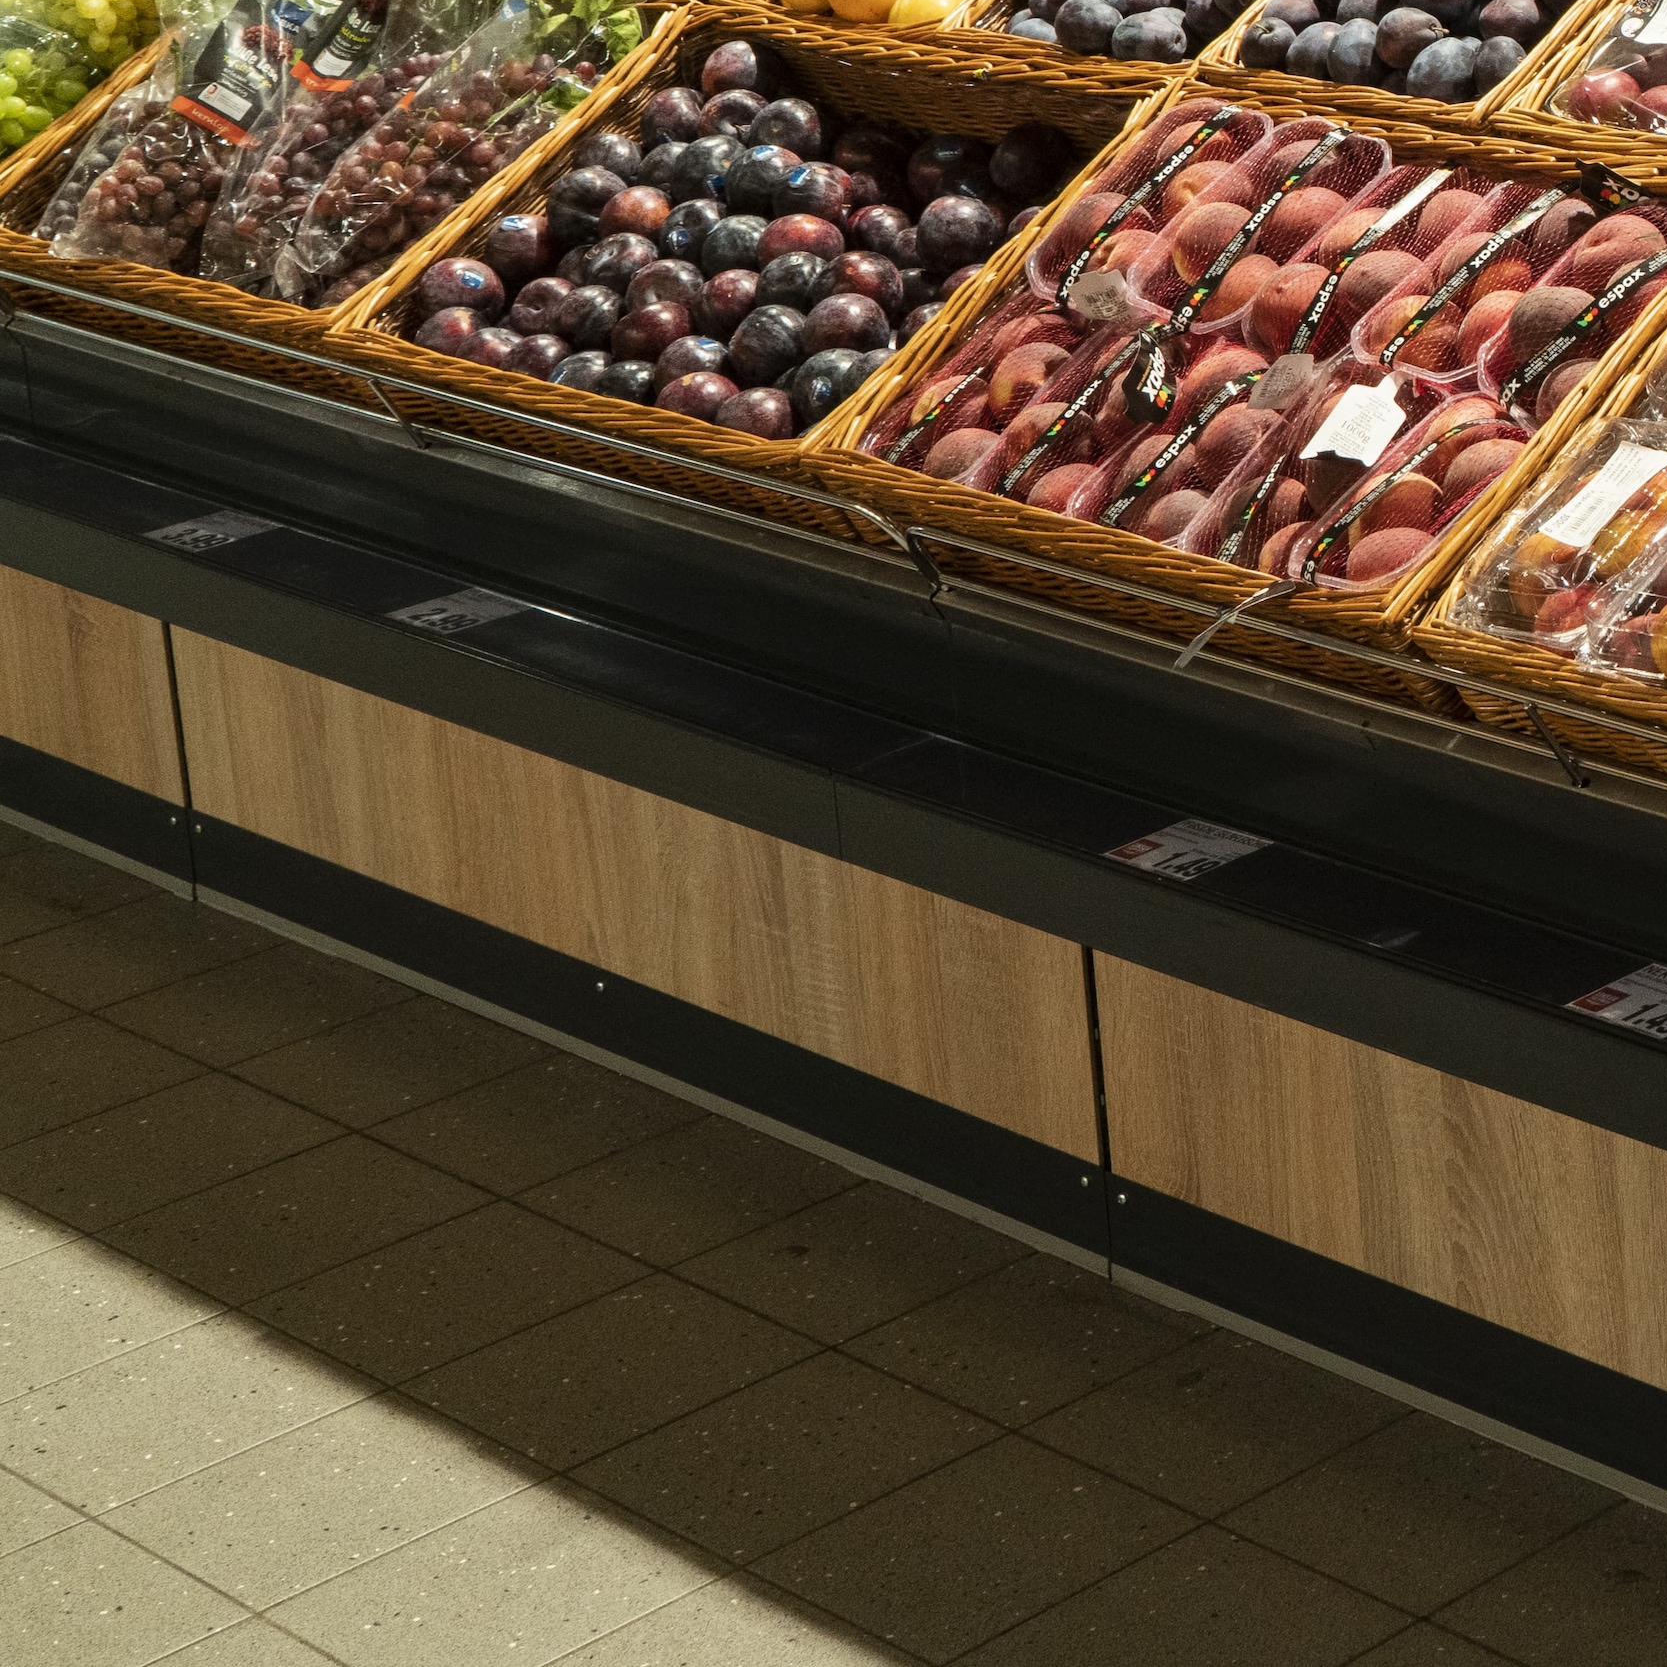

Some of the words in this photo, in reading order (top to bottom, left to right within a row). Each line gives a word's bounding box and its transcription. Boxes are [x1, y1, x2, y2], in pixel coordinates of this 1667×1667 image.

[1152, 144, 1196, 184] espax
[1245, 191, 1284, 233] espax
[1469, 229, 1514, 269] espax
[1305, 273, 1340, 325] espax
[1597, 267, 1647, 310] espax
[944, 366, 984, 403] espax
[1063, 378, 1103, 419] espax
[1154, 422, 1197, 470] espax
[1339, 417, 1372, 445] 1000g
[1255, 452, 1288, 500] espax
